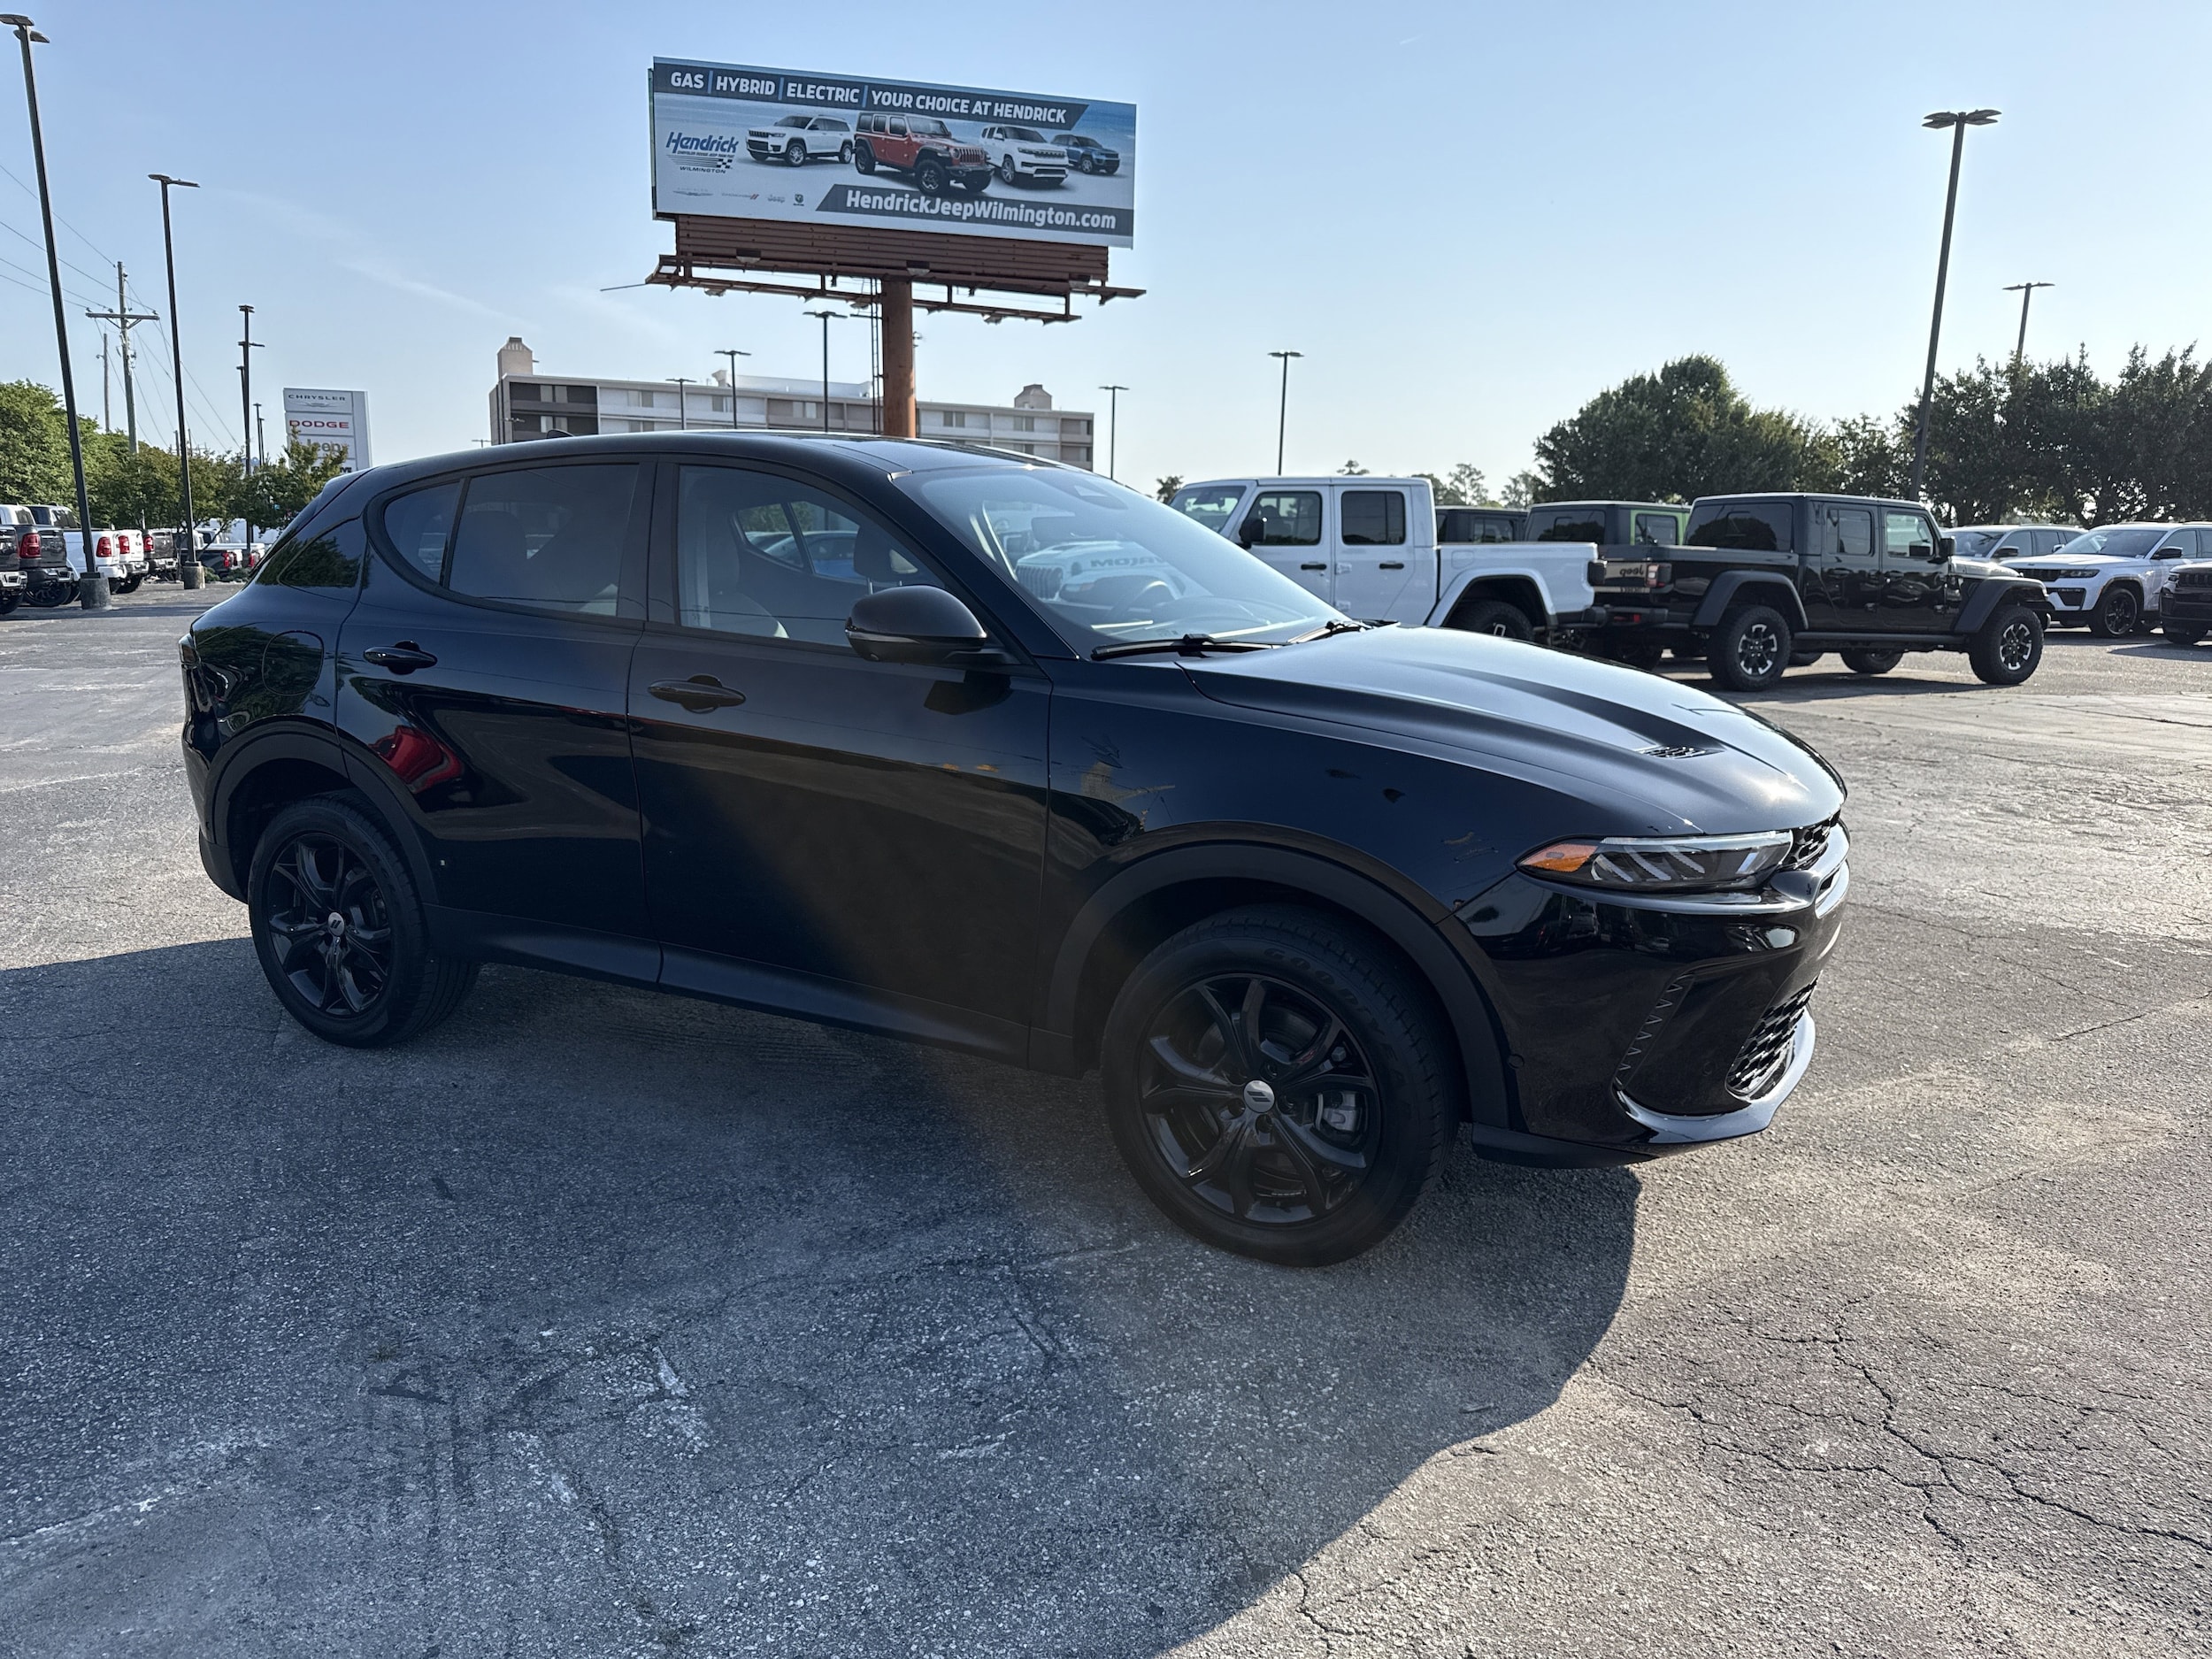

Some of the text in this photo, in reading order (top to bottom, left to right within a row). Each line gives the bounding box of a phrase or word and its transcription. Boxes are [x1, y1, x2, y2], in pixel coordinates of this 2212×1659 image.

[671, 72, 1067, 124] GAS HYBRID ELECTRIC YOUR CHOICE AT HENDRICK
[665, 132, 739, 153] Hendrick
[680, 165, 726, 174] WILMINGTON
[846, 189, 1117, 229] HendrickJeepWilmington.com
[1090, 557, 1164, 566] MOJAV
